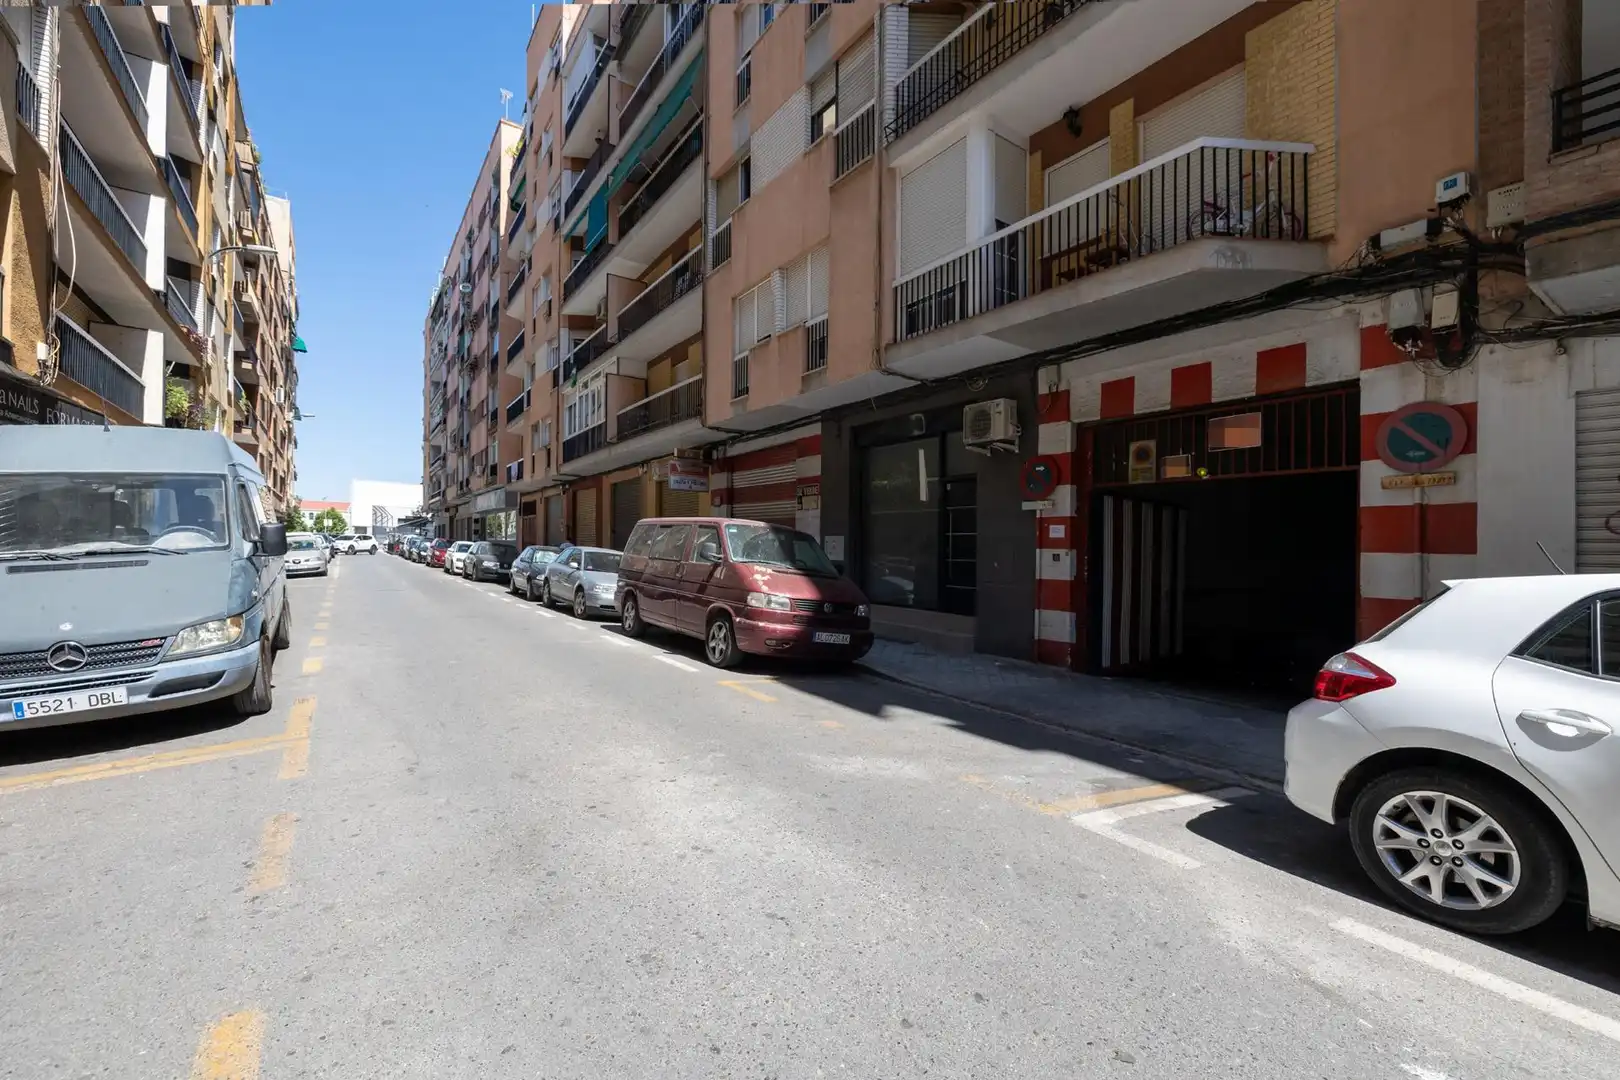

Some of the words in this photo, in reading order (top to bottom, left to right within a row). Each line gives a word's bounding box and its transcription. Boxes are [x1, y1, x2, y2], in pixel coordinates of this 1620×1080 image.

[8, 391, 40, 415] NAILS
[27, 697, 74, 715] 5521
[88, 691, 123, 708] DBL
